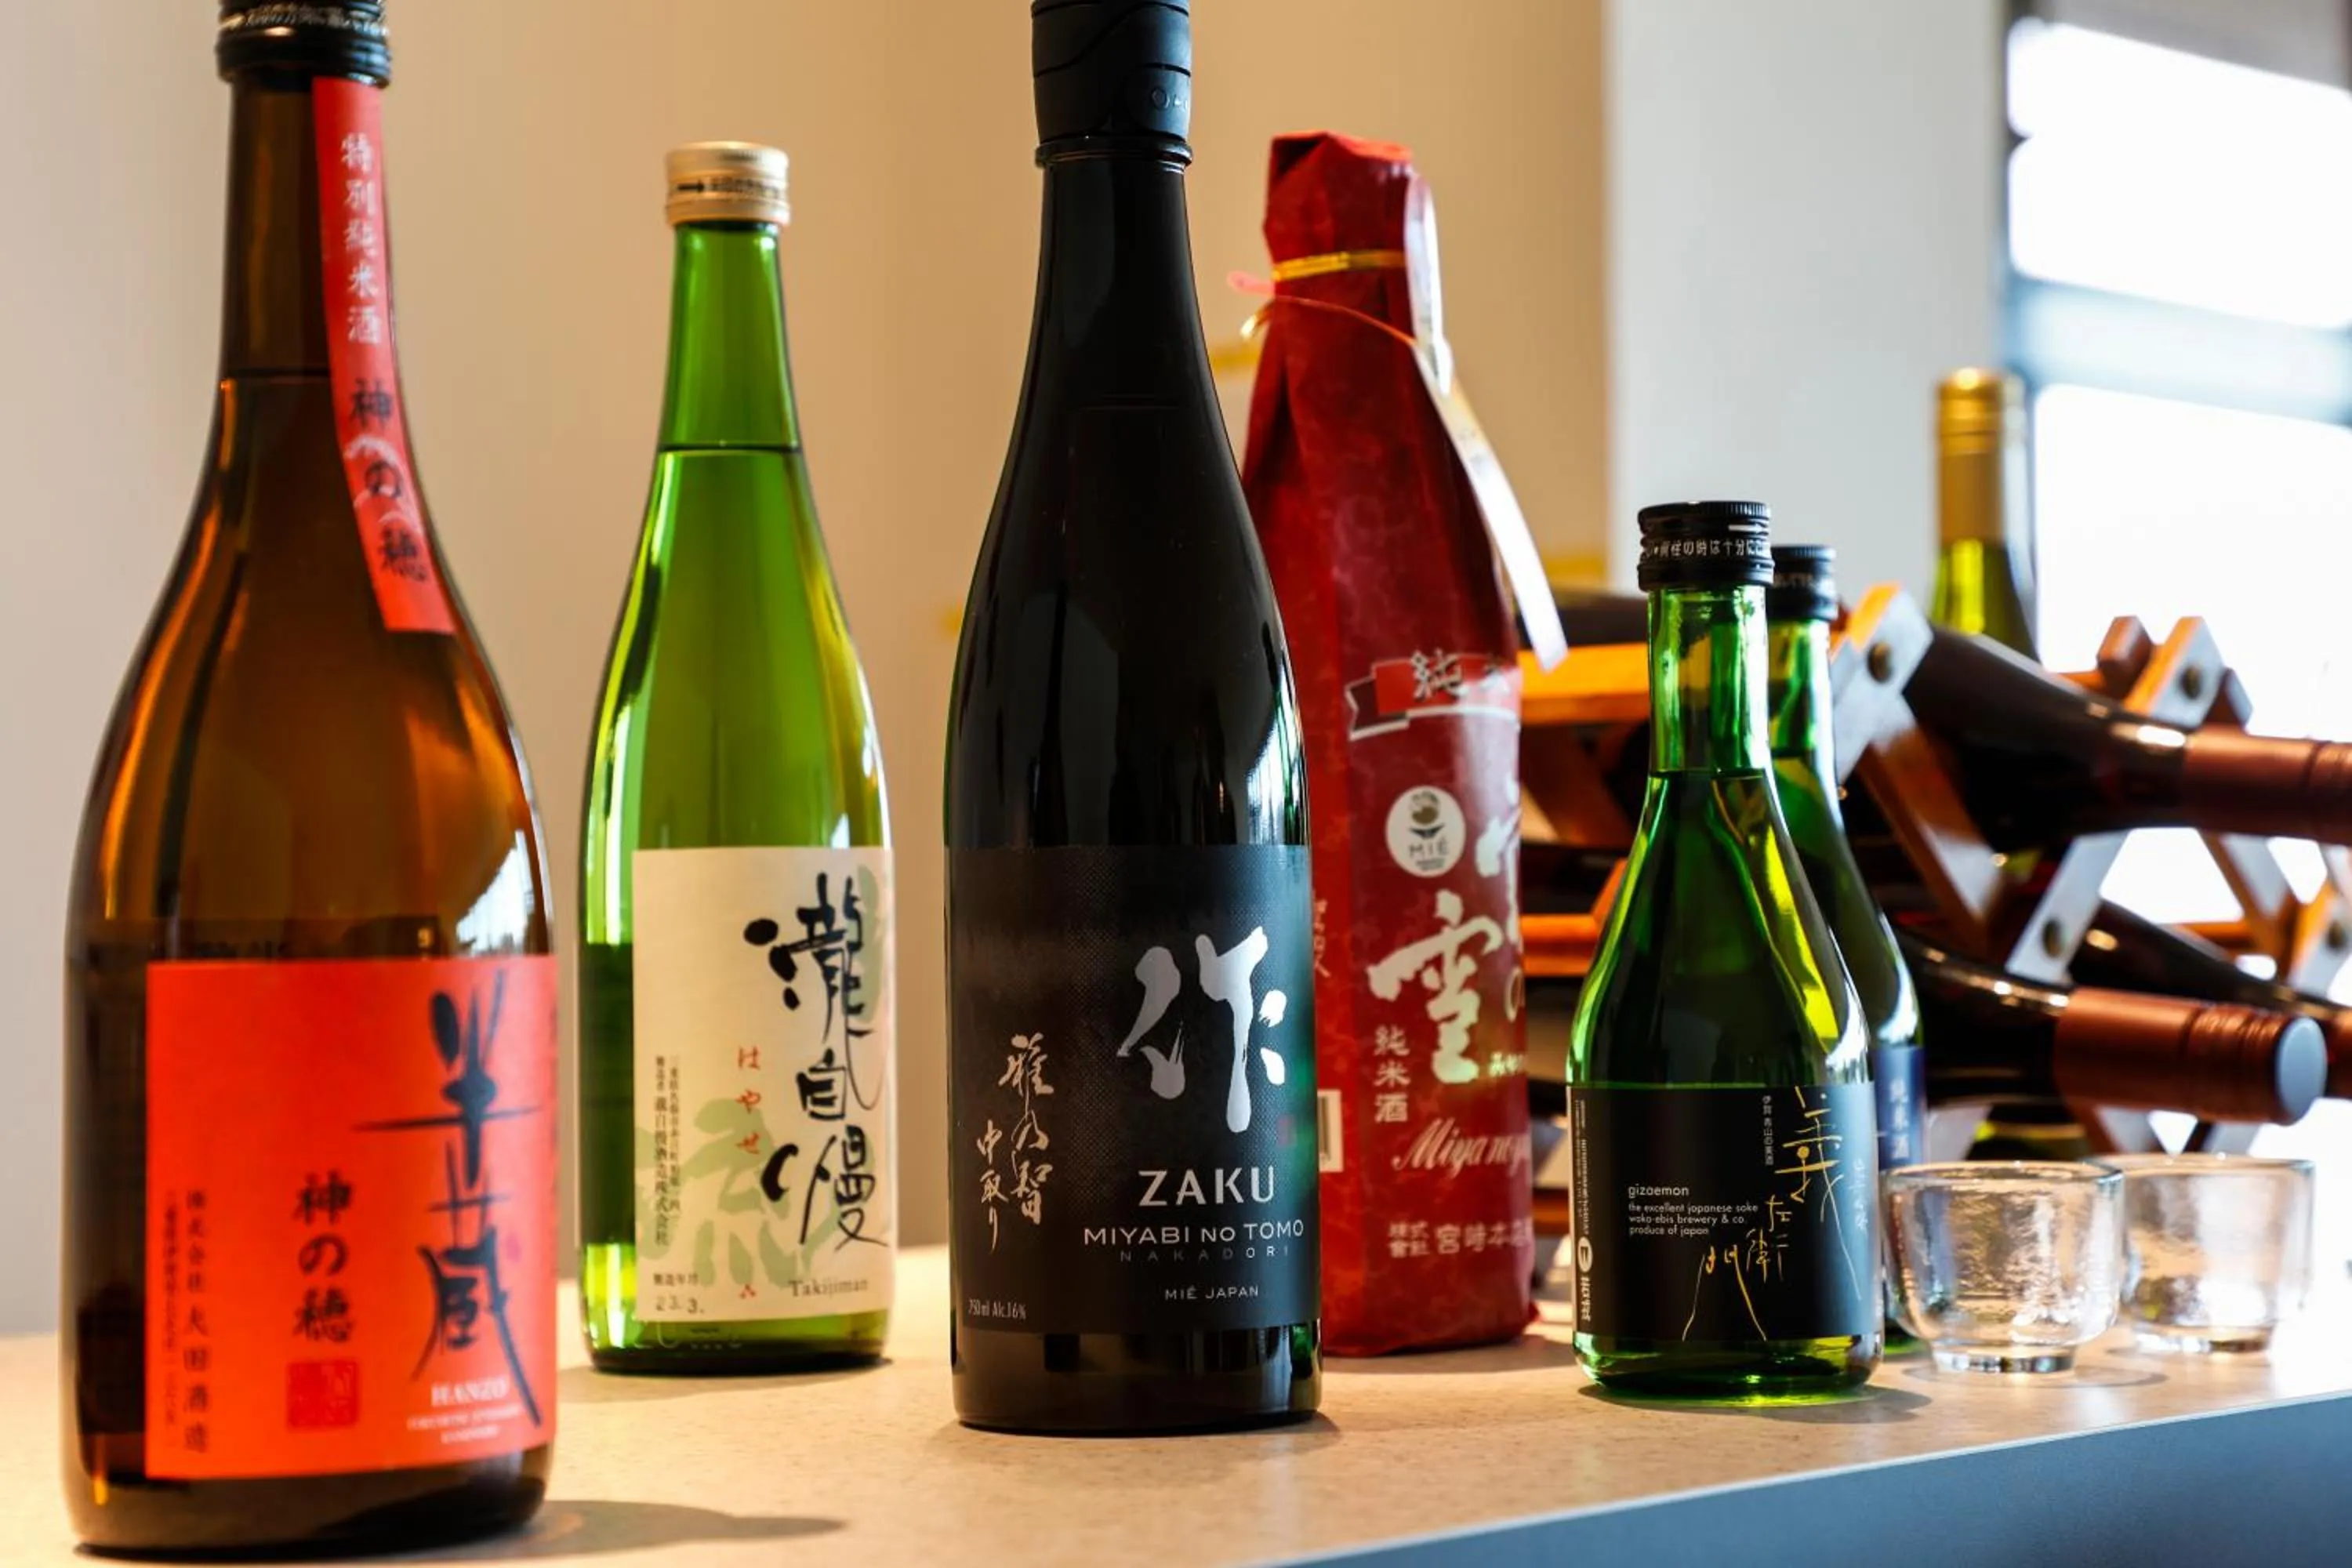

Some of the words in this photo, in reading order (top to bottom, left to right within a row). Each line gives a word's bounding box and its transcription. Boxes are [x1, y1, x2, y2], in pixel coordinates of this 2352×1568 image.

[341, 132, 382, 346] 特別純米酒
[1374, 1023, 1410, 1123] 純米酒
[735, 1045, 761, 1156] はやせ
[976, 1119, 1010, 1254] 中取り
[1138, 1165, 1275, 1207] ZAKU
[1628, 1183, 1690, 1199] gizaemon
[1628, 1203, 1642, 1213] the
[1644, 1202, 1685, 1213] excellent
[1687, 1202, 1732, 1214] japanese
[1735, 1200, 1759, 1213] sake
[1677, 1214, 1718, 1226] brewery
[1721, 1214, 1730, 1224] &
[1084, 1226, 1189, 1246] MIYABI
[1200, 1225, 1236, 1243] NO
[1243, 1219, 1305, 1240] TOMO
[1628, 1225, 1665, 1236] produce
[1668, 1224, 1678, 1236] of
[1679, 1226, 1710, 1239] japan
[292, 1168, 358, 1344] 神の穂
[1120, 1245, 1290, 1263] NAKADORI
[1165, 1287, 1198, 1300] MIÉ
[1205, 1285, 1260, 1300] JAPAN
[431, 1375, 509, 1408] HANZO
